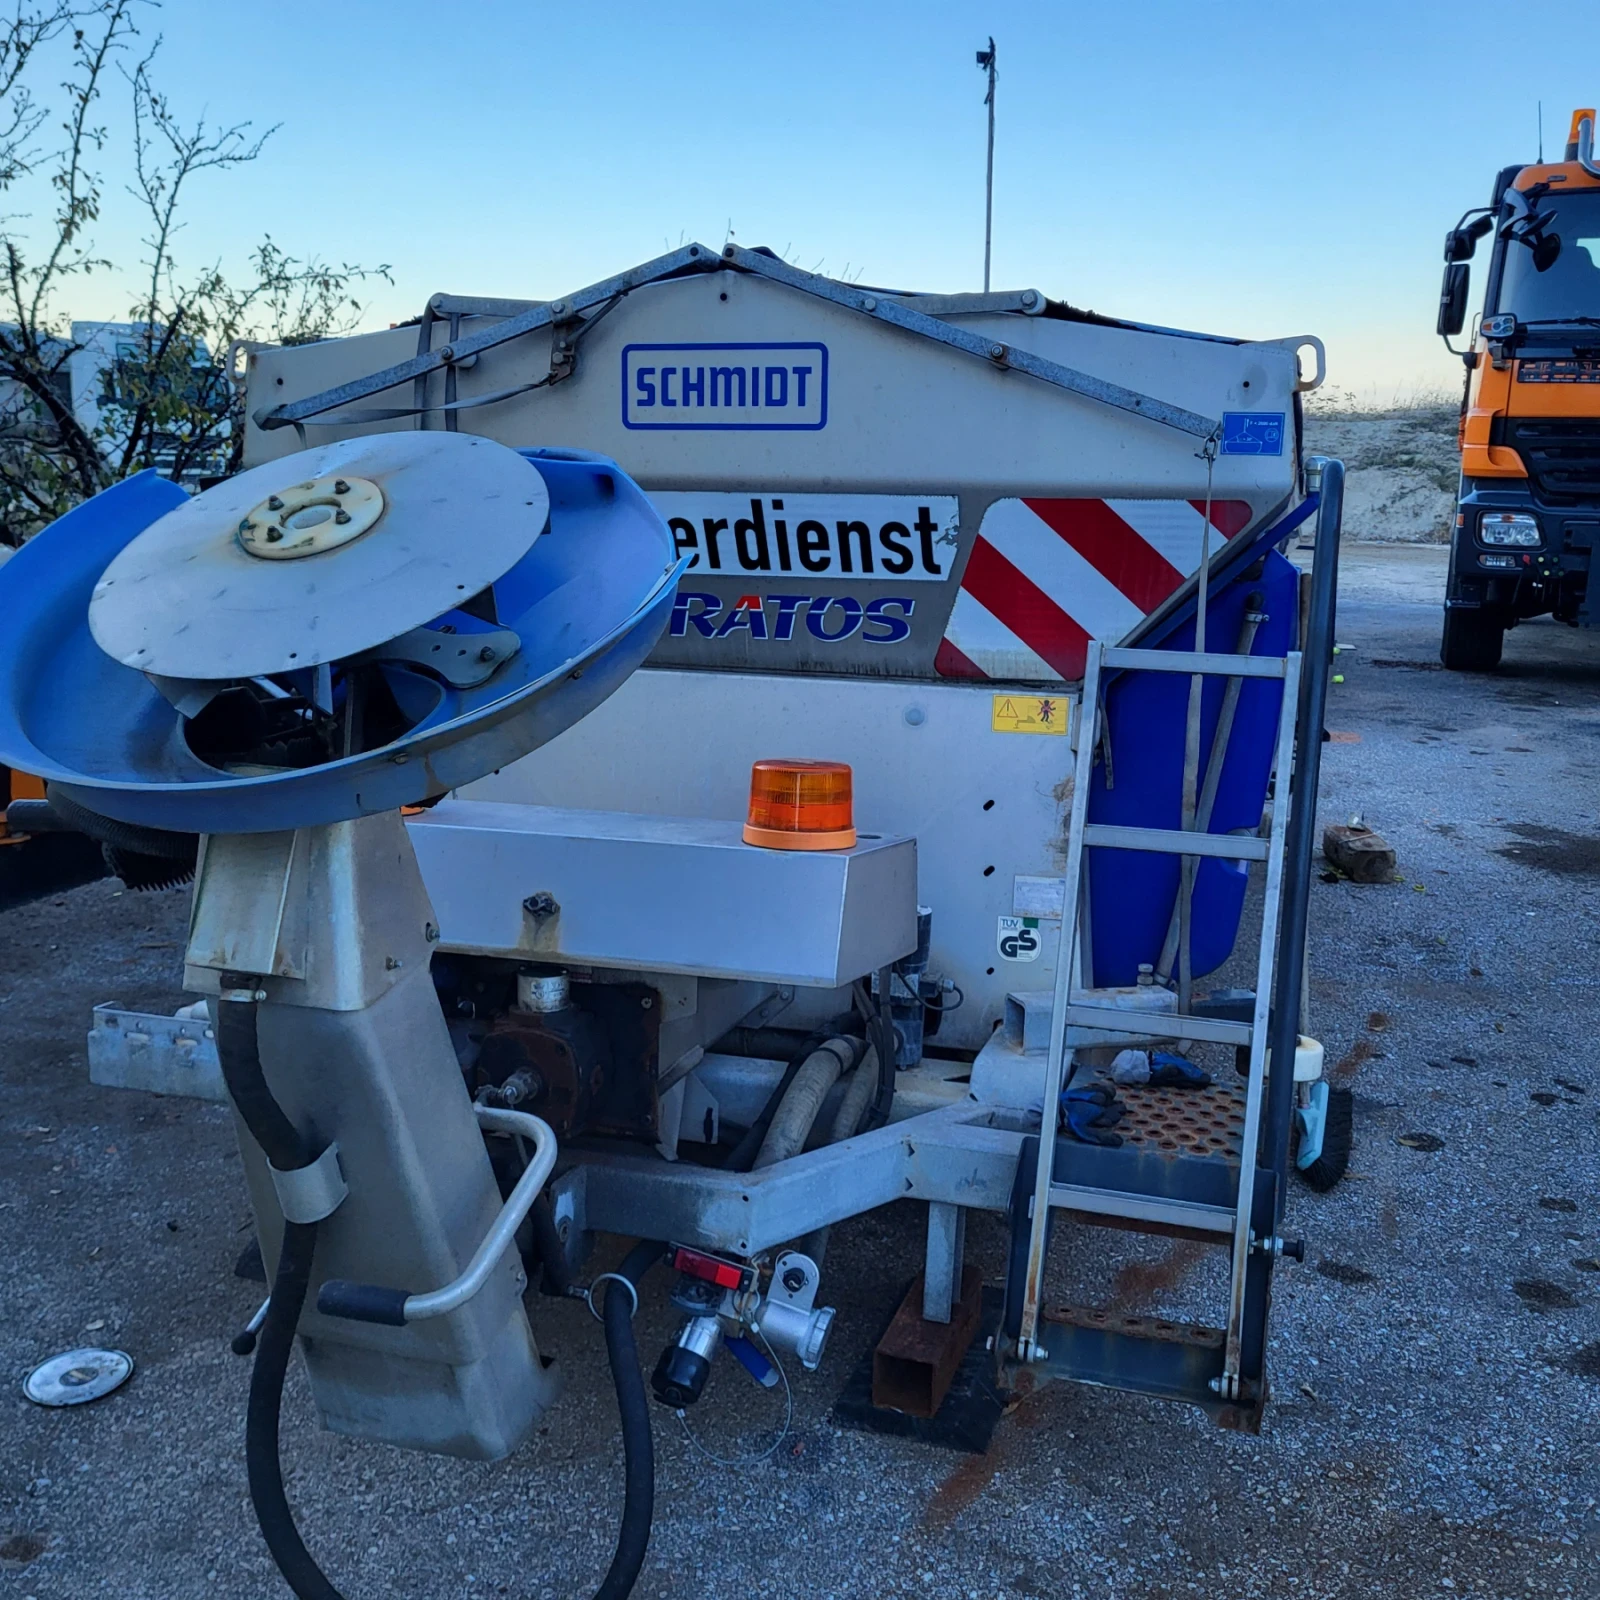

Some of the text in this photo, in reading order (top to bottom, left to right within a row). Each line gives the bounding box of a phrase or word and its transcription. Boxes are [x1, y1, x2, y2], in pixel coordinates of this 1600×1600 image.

[637, 366, 812, 407] SCHMIDT
[670, 592, 916, 644] RATOS
[1000, 929, 1037, 958] GS
